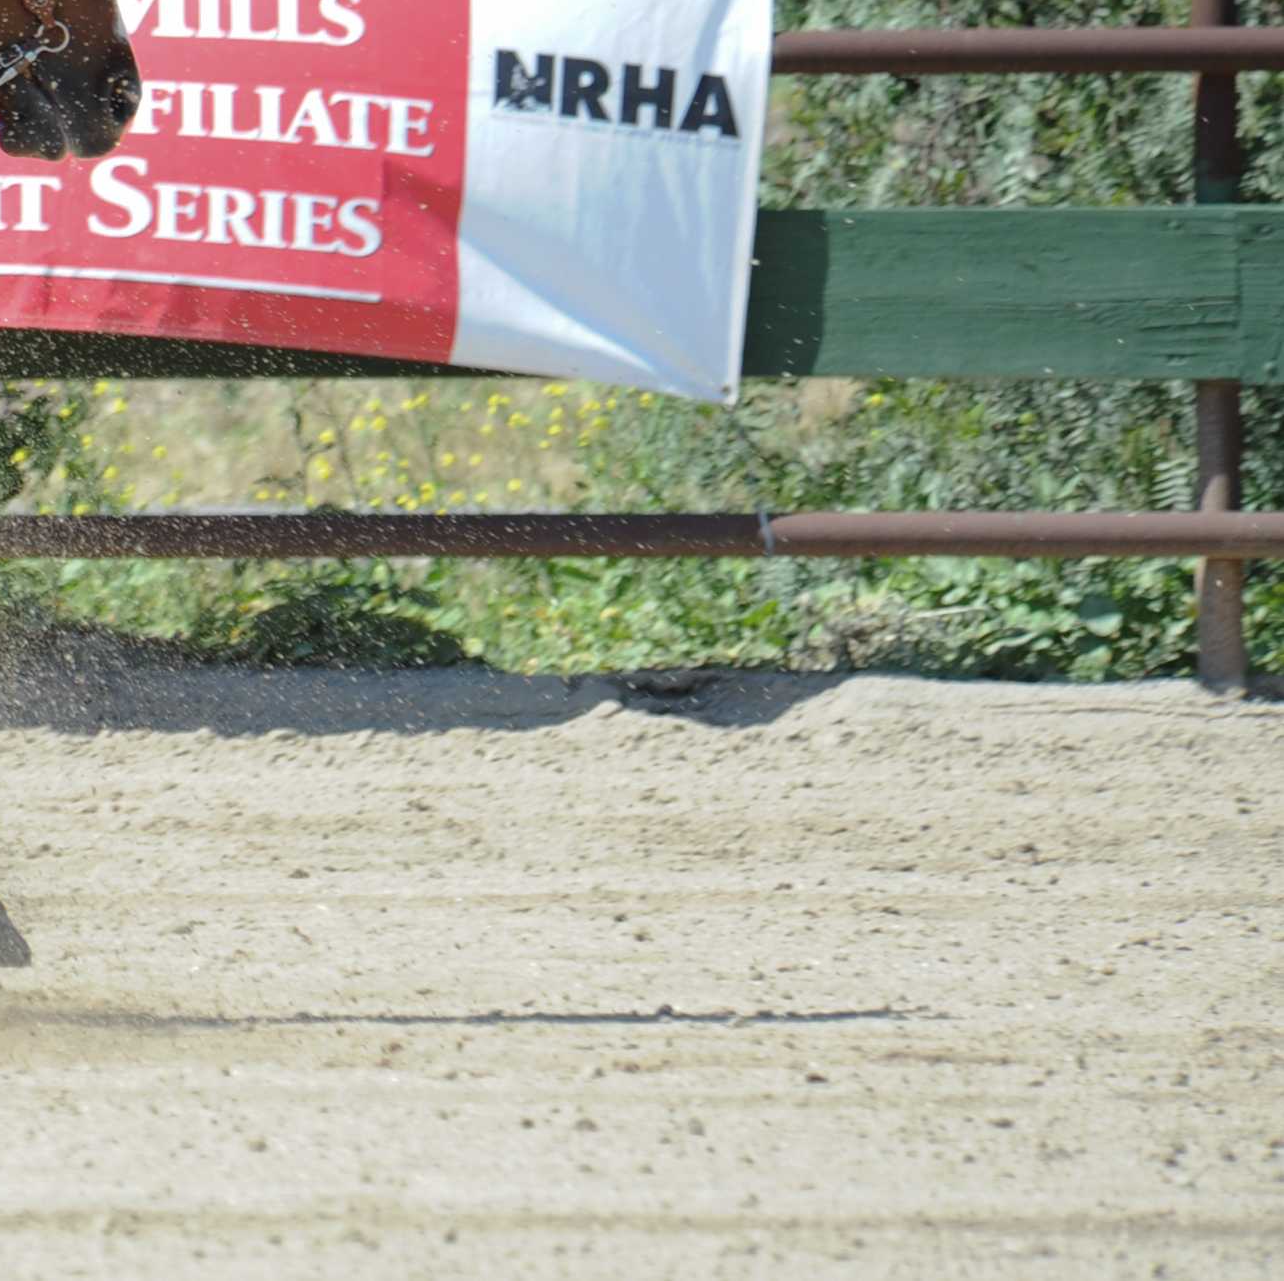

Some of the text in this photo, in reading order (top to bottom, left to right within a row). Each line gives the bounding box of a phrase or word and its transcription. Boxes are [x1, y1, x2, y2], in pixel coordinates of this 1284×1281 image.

[126, 79, 435, 157] FILIATE
[492, 48, 742, 139] NRHA
[87, 155, 383, 258] SERIES
